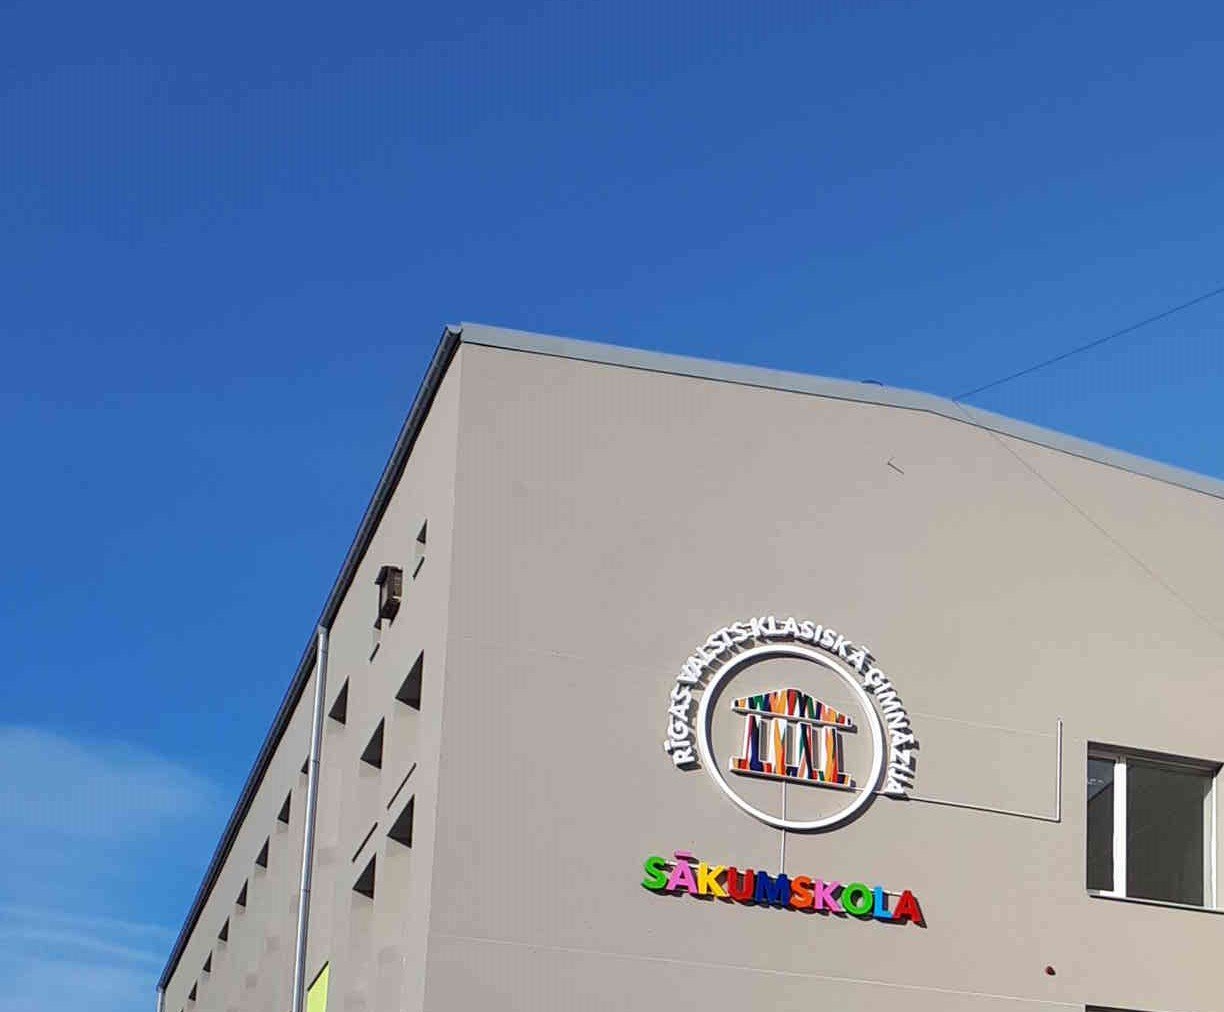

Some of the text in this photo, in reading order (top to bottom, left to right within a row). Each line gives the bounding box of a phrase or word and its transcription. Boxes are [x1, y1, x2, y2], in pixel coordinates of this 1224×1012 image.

[677, 620, 752, 684] VALSTS
[750, 615, 872, 673] KLASISKĀ
[663, 682, 696, 765] RĪGAS
[641, 850, 924, 926] SĀKUMSKOLA
